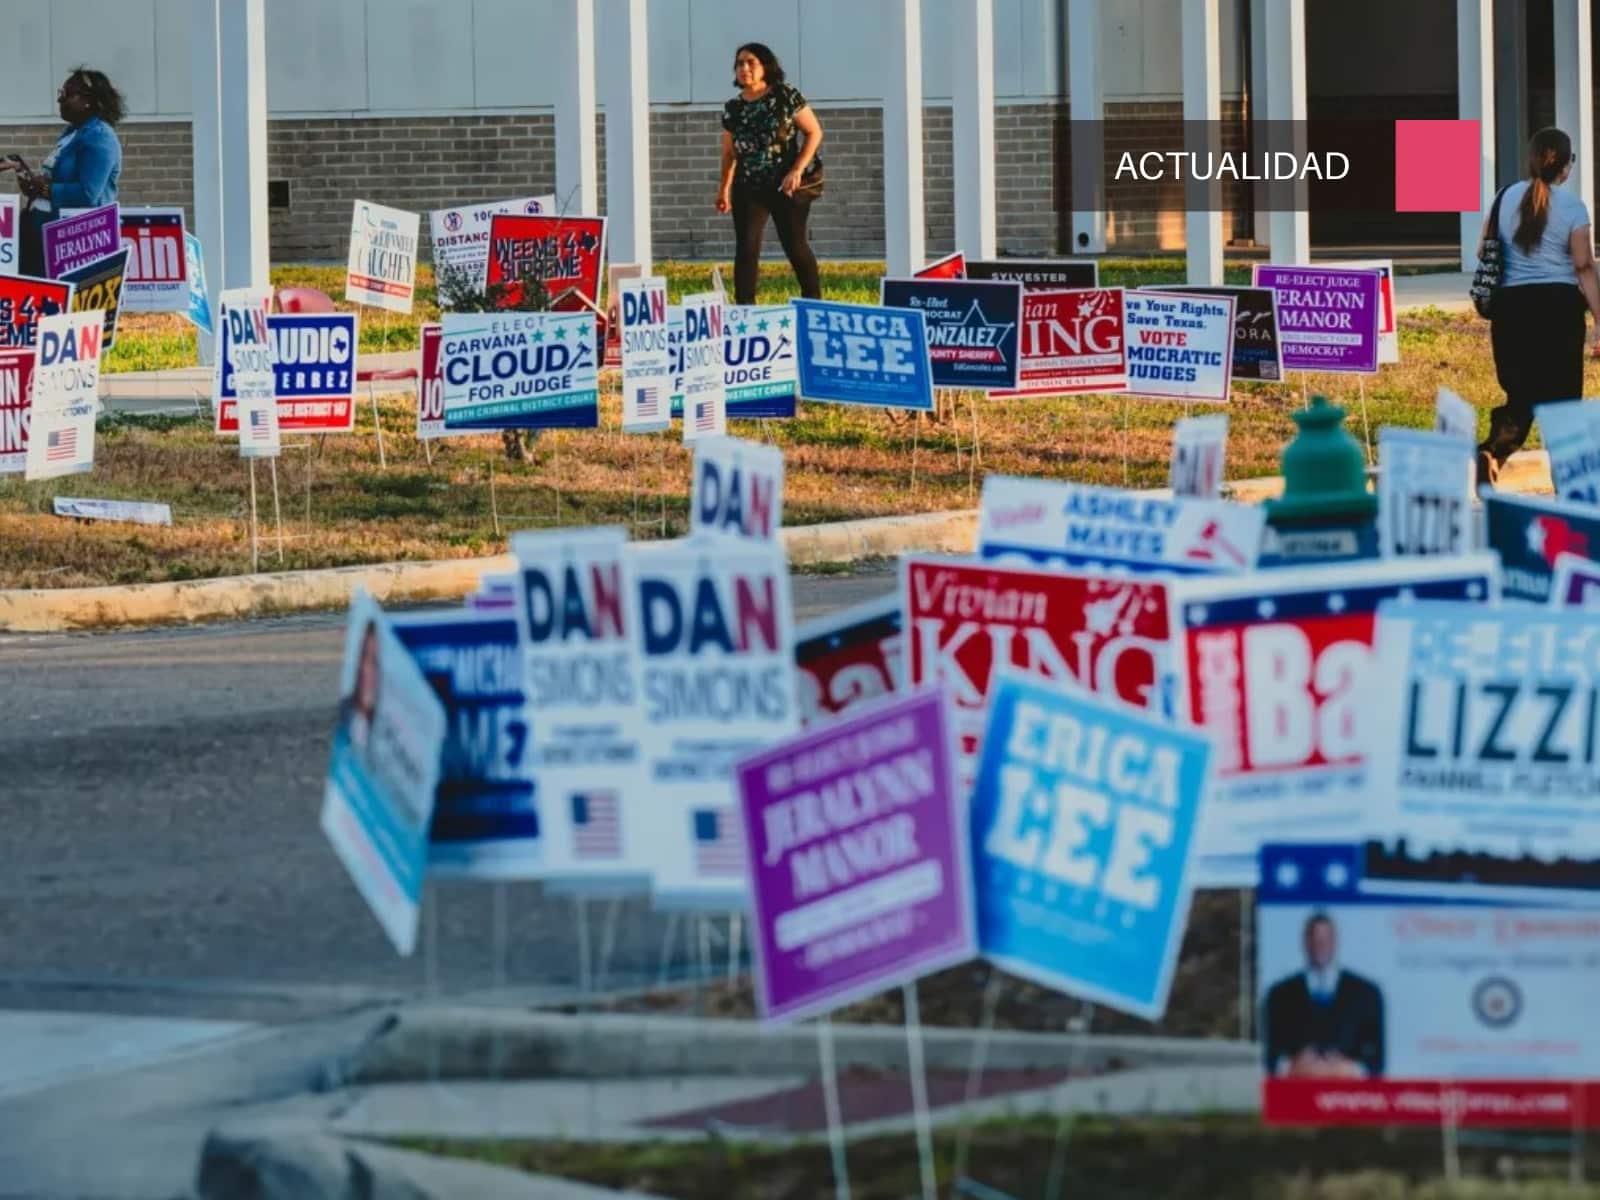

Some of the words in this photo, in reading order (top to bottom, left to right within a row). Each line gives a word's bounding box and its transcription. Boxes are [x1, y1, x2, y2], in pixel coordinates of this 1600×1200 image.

[53, 229, 113, 265] JERALYNN
[991, 271, 1067, 283] SYLVESTER
[1276, 274, 1325, 284] RE-ELECT
[1327, 277, 1360, 289] JUDGE
[623, 289, 666, 326] DAN
[685, 304, 722, 343] DAN
[805, 309, 911, 338] ERICA
[1128, 313, 1160, 326] Save
[1164, 315, 1208, 329] Texas.
[1146, 300, 1177, 313] Your
[1181, 302, 1228, 317] Rights.
[1281, 310, 1353, 329] MANOR
[229, 309, 267, 345] DAN
[491, 316, 545, 333] ELECT
[624, 327, 667, 354] SIMONS
[1140, 330, 1188, 347] VOTE
[40, 325, 99, 366] DAN
[445, 333, 527, 355] CARVANA
[808, 331, 916, 375] LEE
[1283, 344, 1345, 356] DEMOCRAT
[37, 364, 96, 396] SONS
[446, 344, 570, 386] CLOUD
[1129, 364, 1197, 383] JUDGES
[468, 383, 504, 401] FOR
[510, 375, 572, 397] JUDGE
[476, 402, 518, 417] CRIMINAL
[521, 396, 561, 411] DISTRICT
[563, 391, 594, 405] COURT
[700, 459, 775, 539] DAN
[1062, 493, 1182, 525] ASHLEY
[1067, 523, 1164, 556] MAYES
[523, 563, 625, 642] DAN
[912, 570, 1047, 623] Vivian
[640, 575, 779, 655] DAN
[911, 615, 1162, 710] KING
[646, 667, 787, 724] SIMONS
[1008, 704, 1183, 808] ERICA
[984, 763, 1177, 907] LEE
